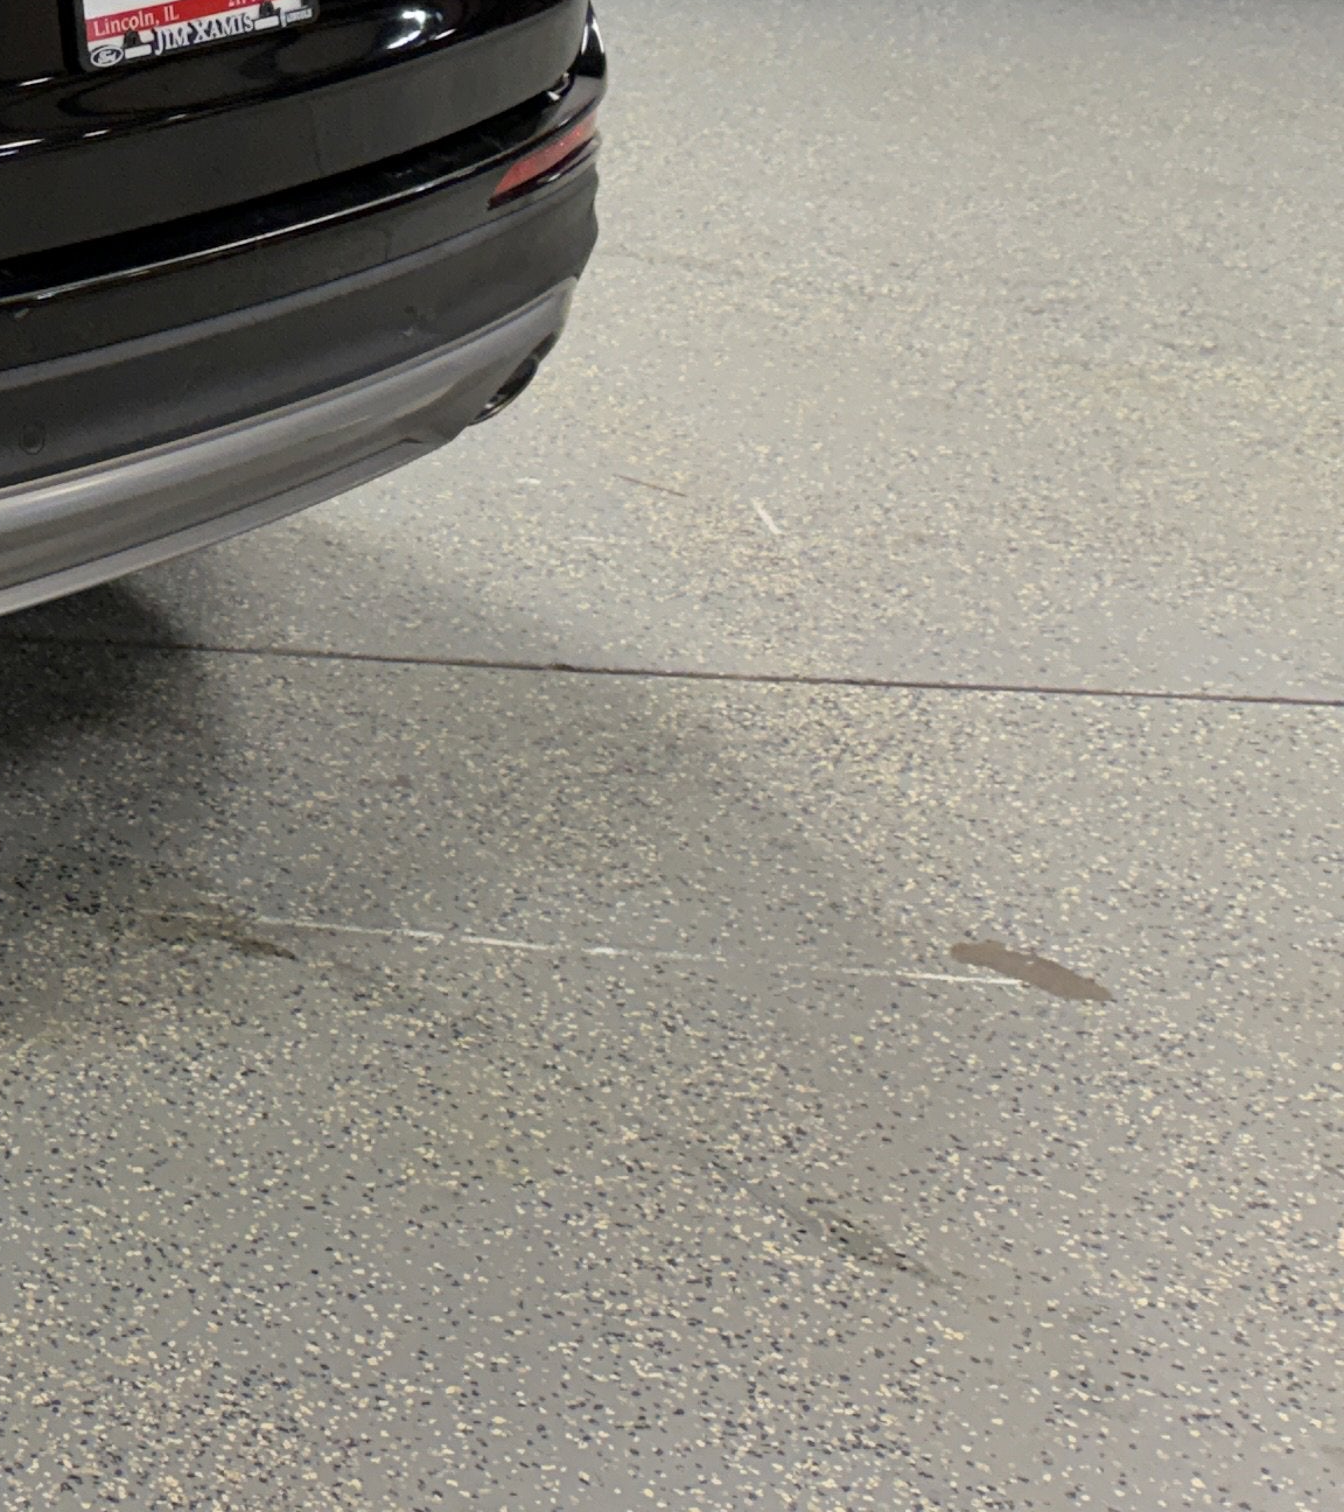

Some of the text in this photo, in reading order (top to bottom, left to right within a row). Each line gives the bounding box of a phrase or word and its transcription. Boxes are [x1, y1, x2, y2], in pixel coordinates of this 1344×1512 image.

[163, 5, 180, 23] IL
[154, 27, 193, 56] JIM
[192, 13, 254, 44] XAMIS
